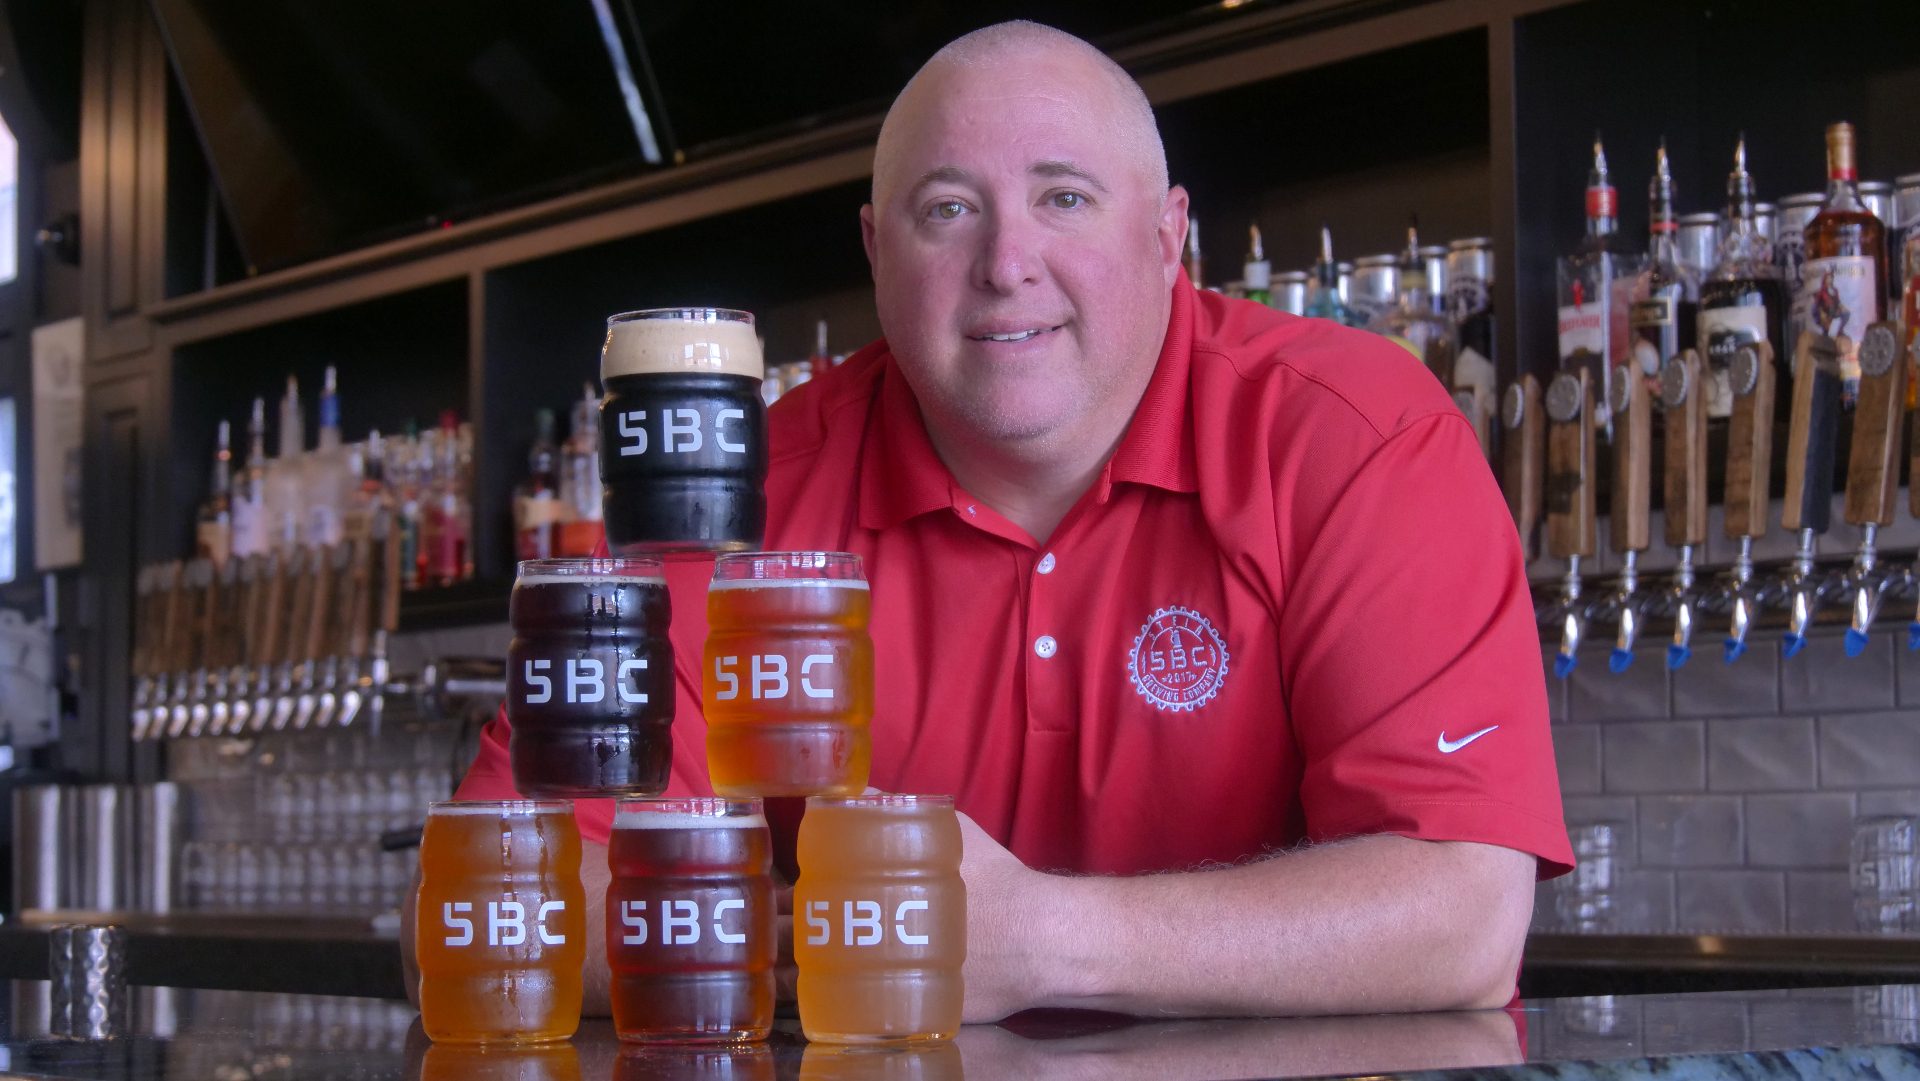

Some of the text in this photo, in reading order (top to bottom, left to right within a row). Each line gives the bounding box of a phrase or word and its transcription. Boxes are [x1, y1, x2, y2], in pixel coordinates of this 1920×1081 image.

[1150, 646, 1208, 671] SBC
[1142, 667, 1217, 701] BREWING COMPANY
